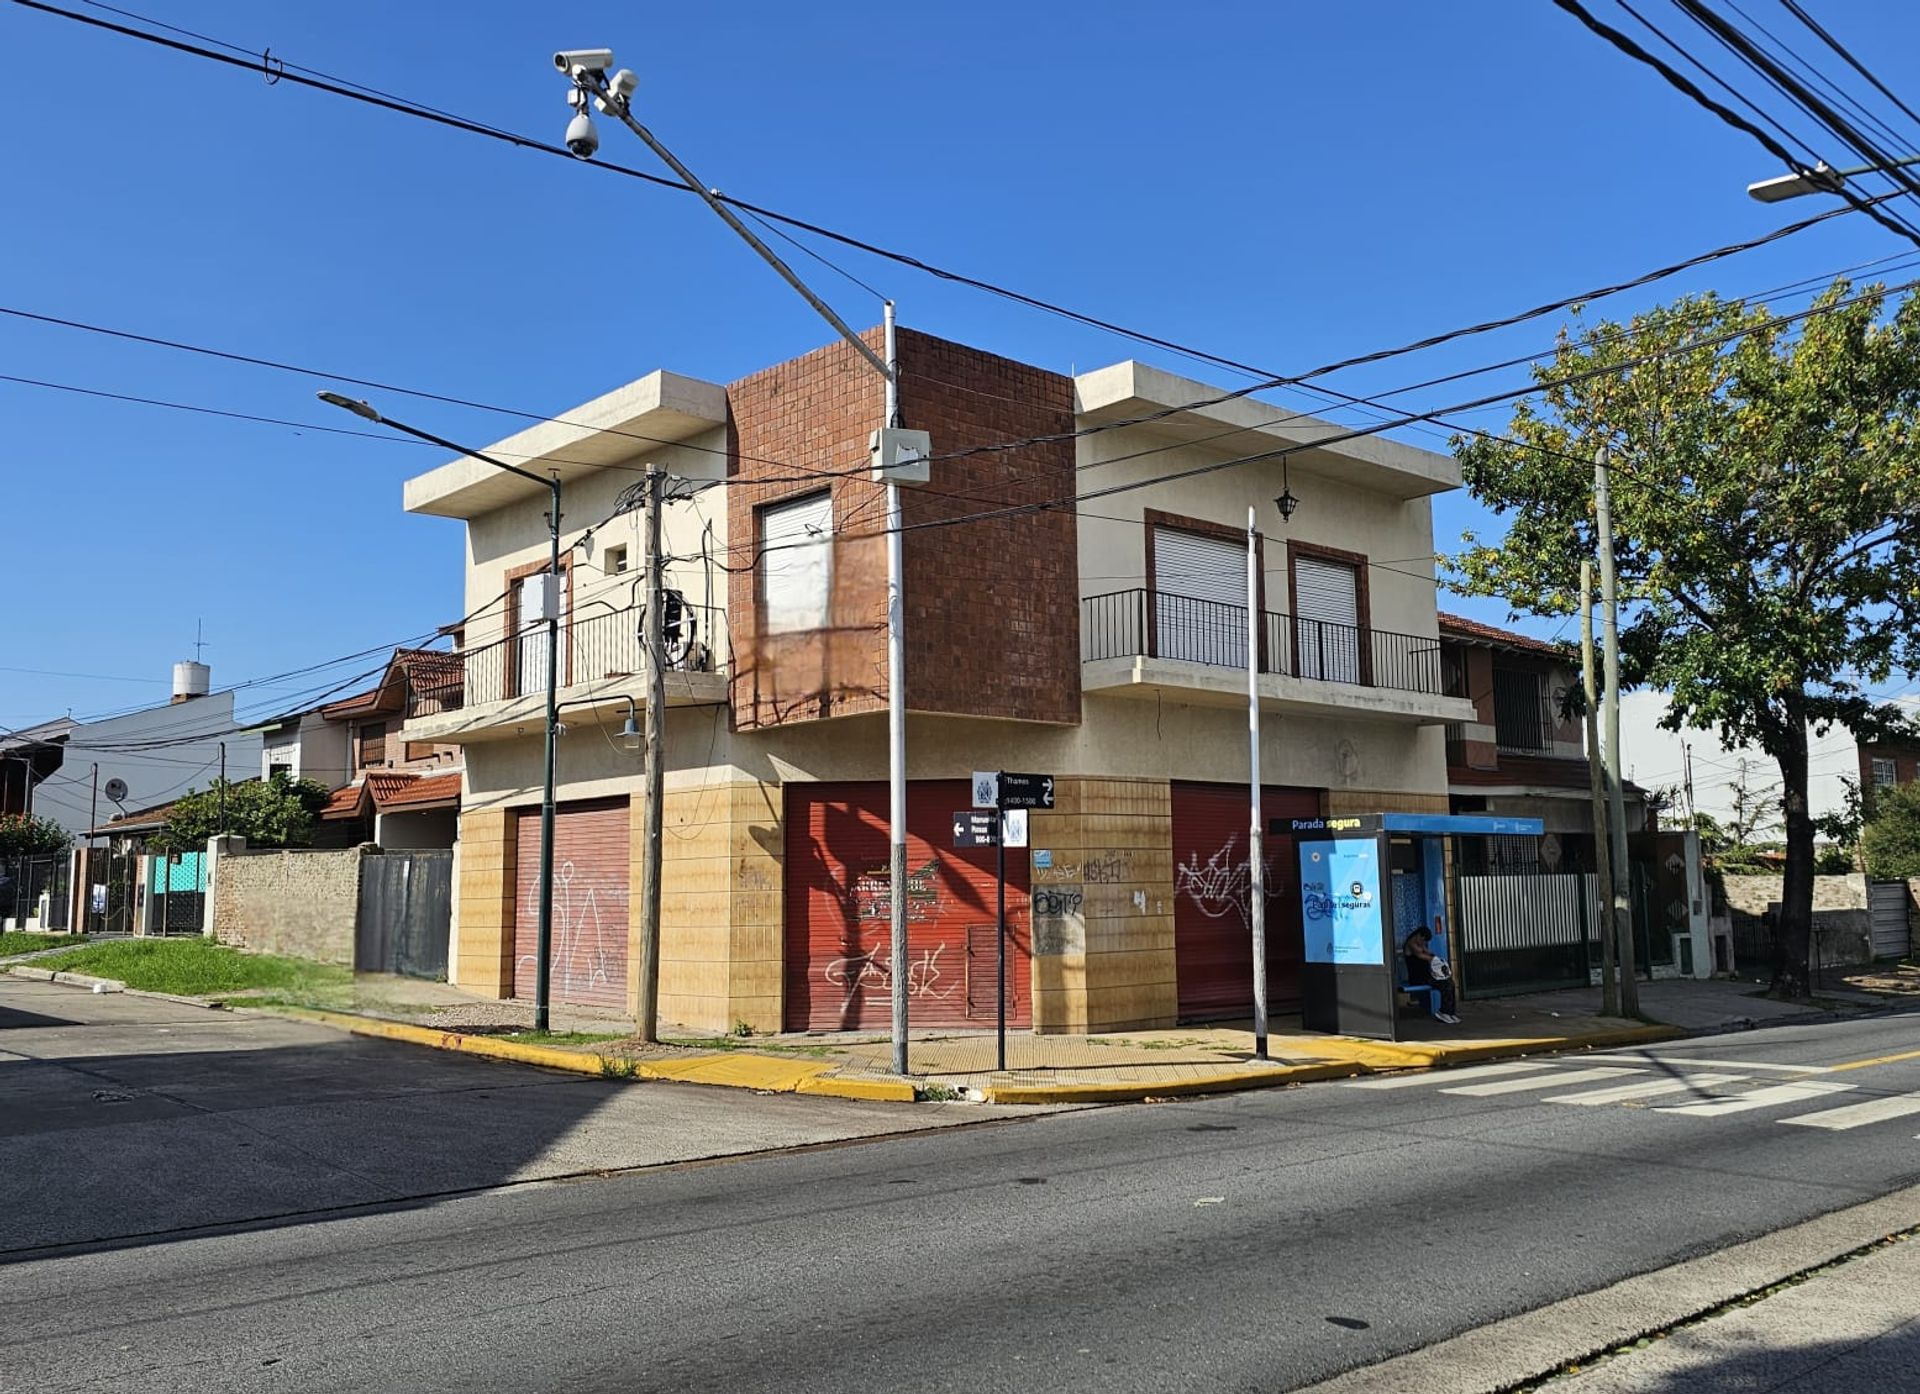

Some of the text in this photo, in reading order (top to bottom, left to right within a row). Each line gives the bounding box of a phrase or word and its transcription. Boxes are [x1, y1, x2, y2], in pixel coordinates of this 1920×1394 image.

[1006, 776, 1030, 786] Thames
[1292, 818, 1361, 831] Parada segura
[1341, 900, 1371, 910] seguras
